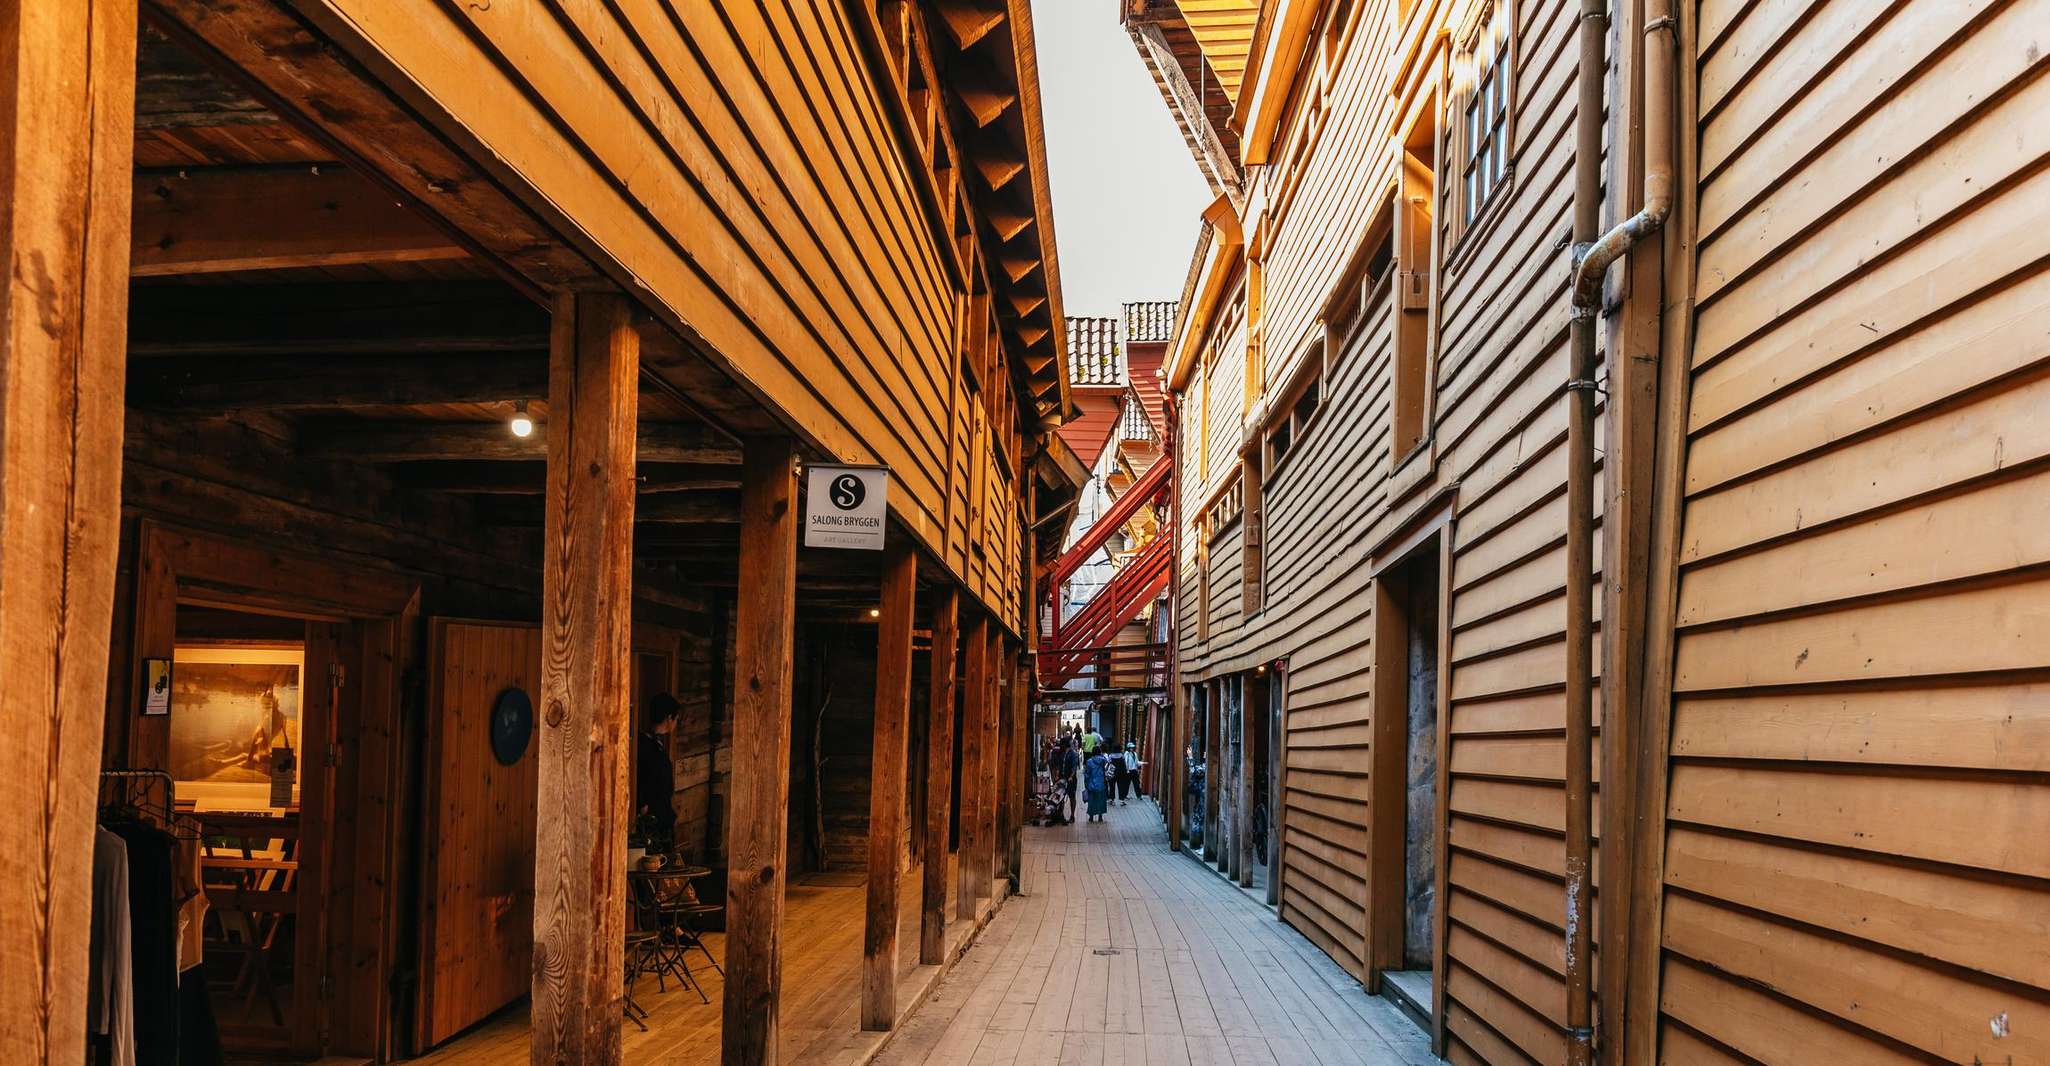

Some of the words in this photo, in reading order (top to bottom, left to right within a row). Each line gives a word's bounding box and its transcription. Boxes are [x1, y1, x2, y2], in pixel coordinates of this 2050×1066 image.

[837, 477, 856, 507] S
[812, 515, 842, 526] SALONG
[844, 516, 880, 528] BRYGGEN
